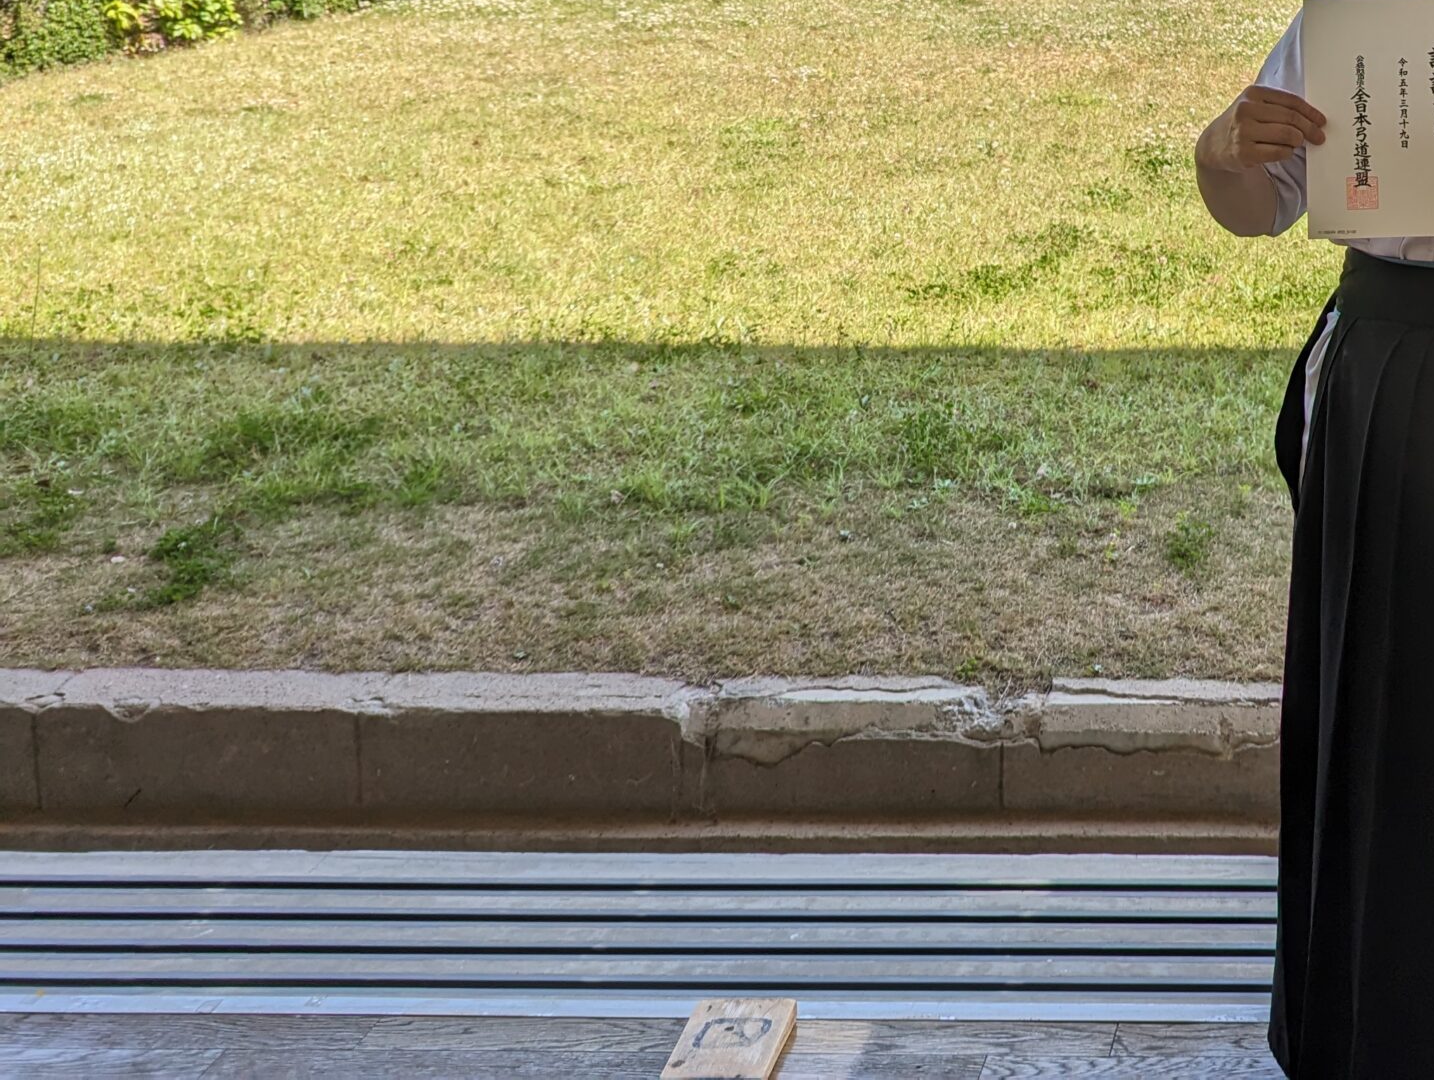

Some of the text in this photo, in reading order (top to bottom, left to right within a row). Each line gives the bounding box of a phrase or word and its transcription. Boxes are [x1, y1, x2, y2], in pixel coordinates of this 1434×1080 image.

[1397, 57, 1410, 149] 令和五年三月十九日
